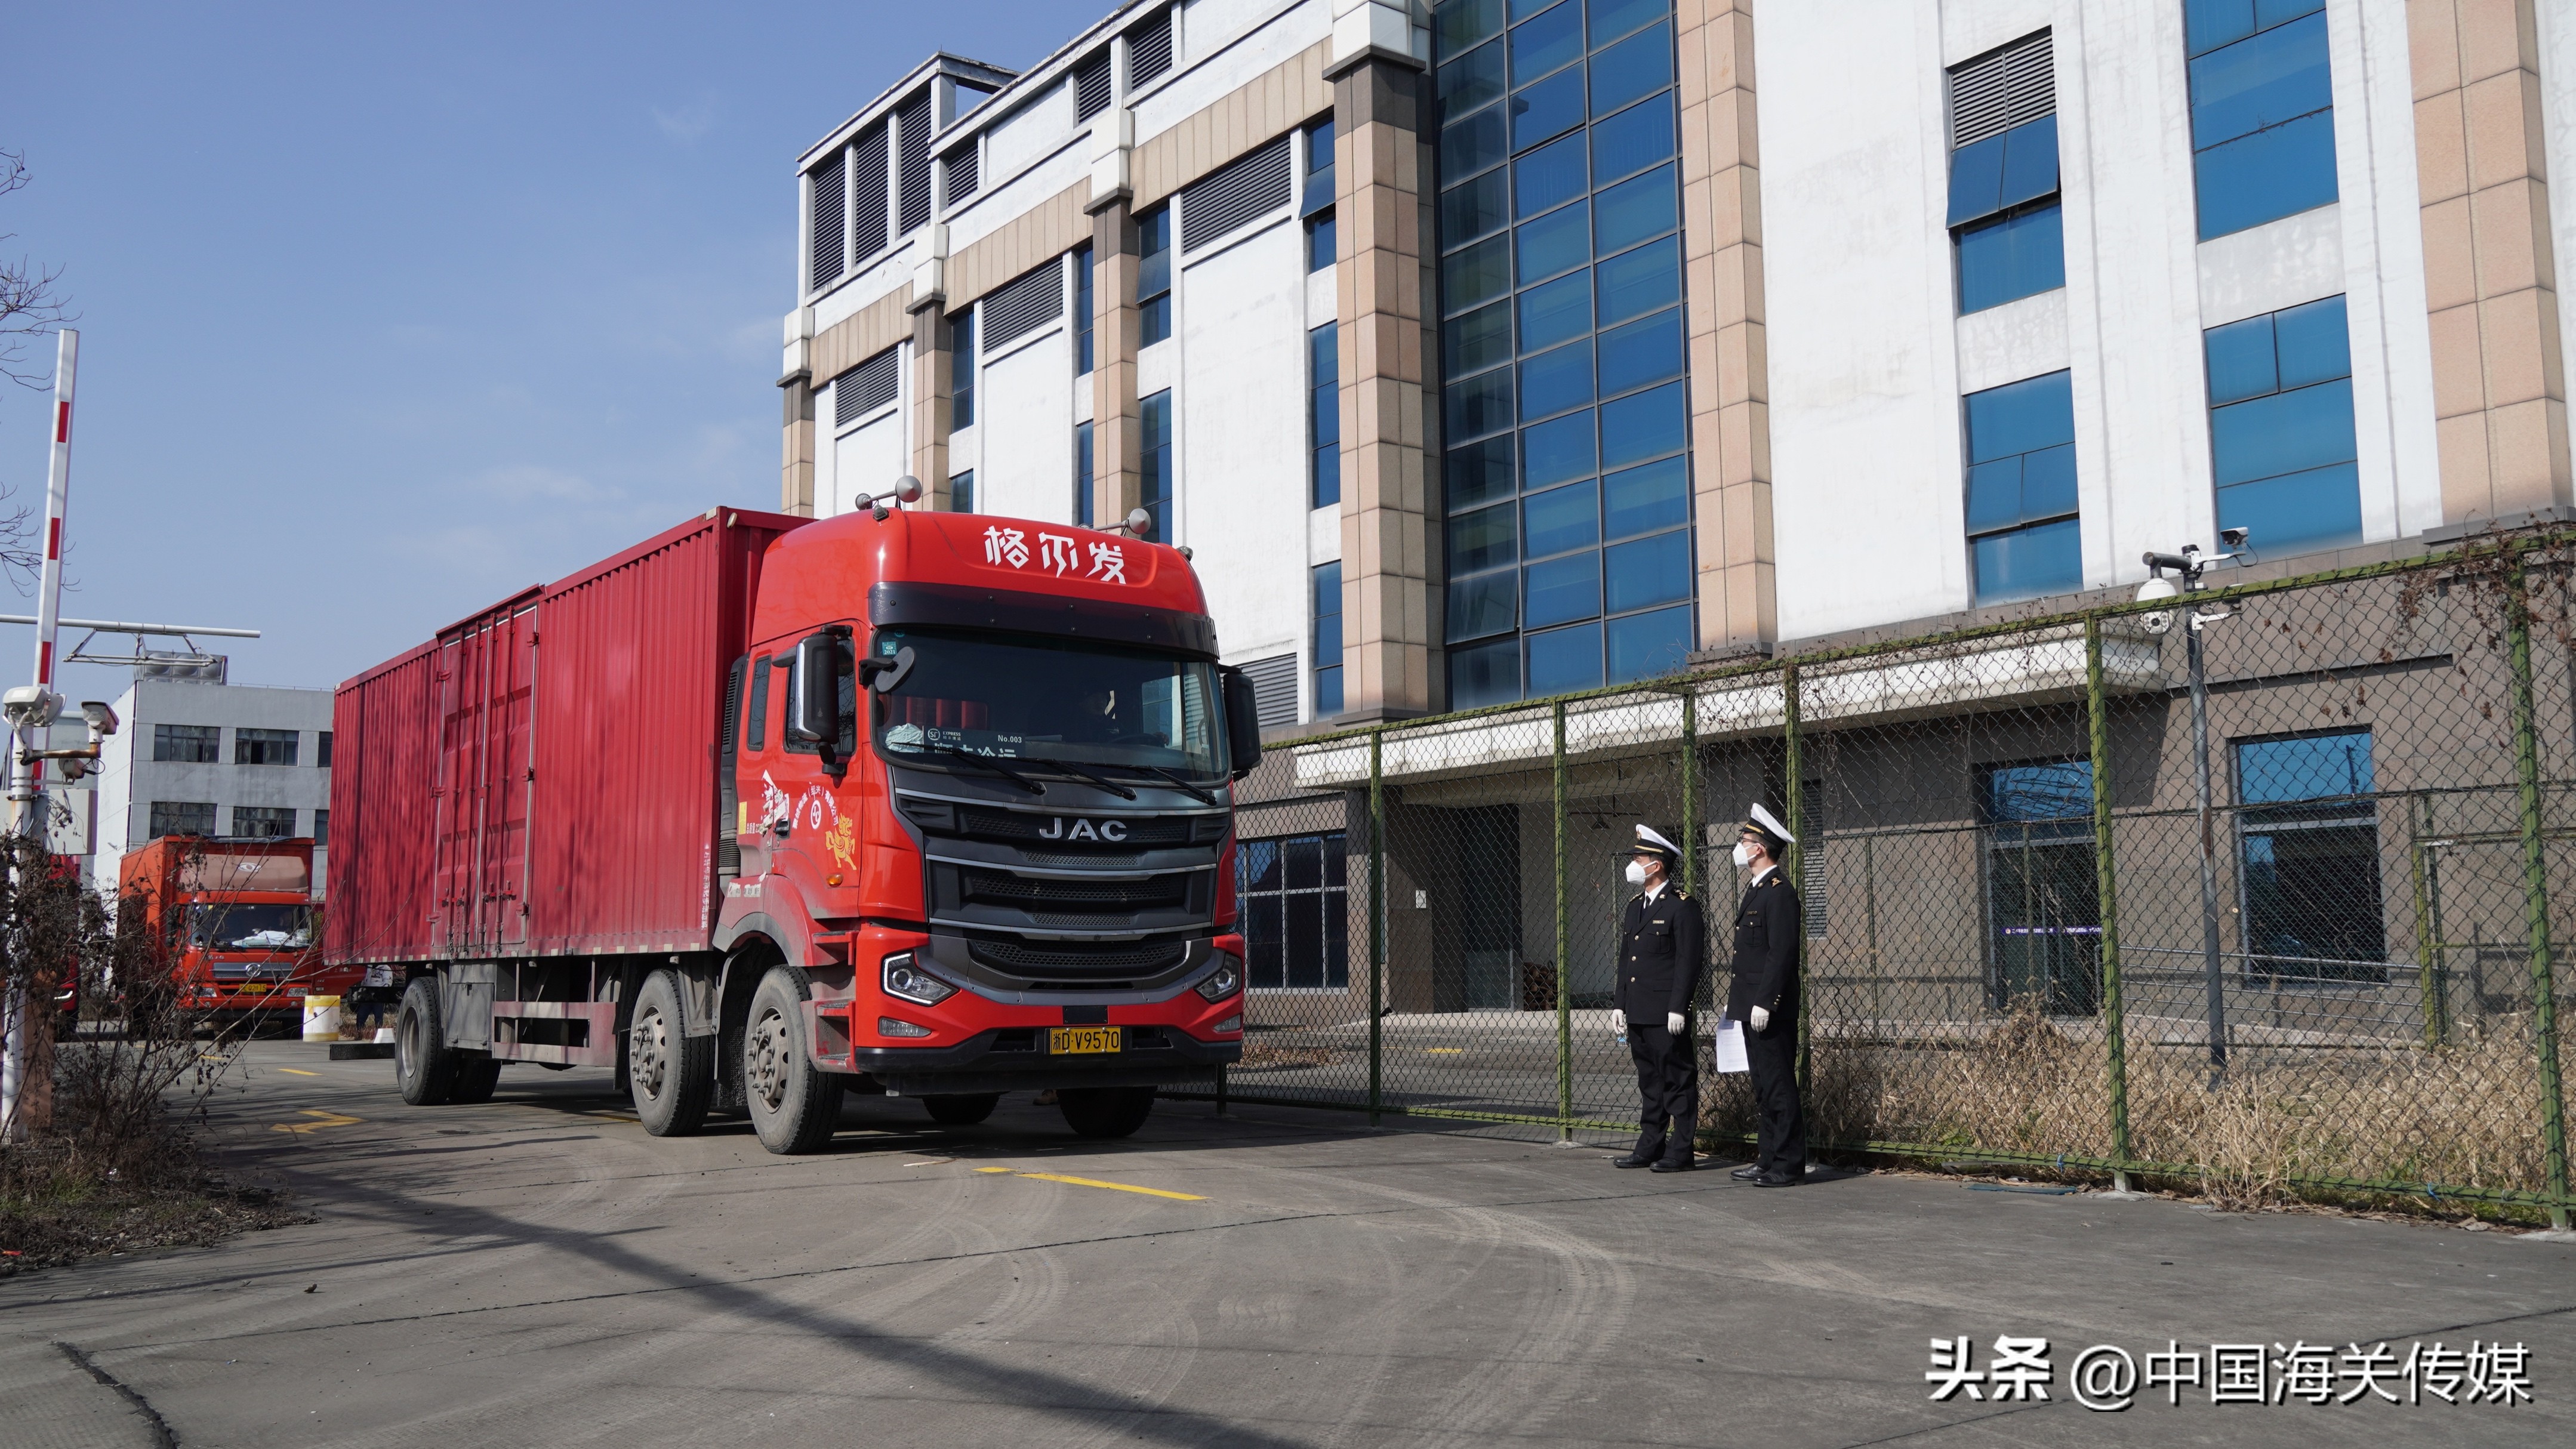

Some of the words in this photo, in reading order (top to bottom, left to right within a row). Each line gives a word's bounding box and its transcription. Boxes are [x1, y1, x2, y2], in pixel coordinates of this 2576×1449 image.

[983, 525, 1126, 584] 格尔发
[998, 735, 1022, 744] No.003
[1039, 817, 1127, 841] JAC
[1053, 1031, 1119, 1050] 浙D·V9570
